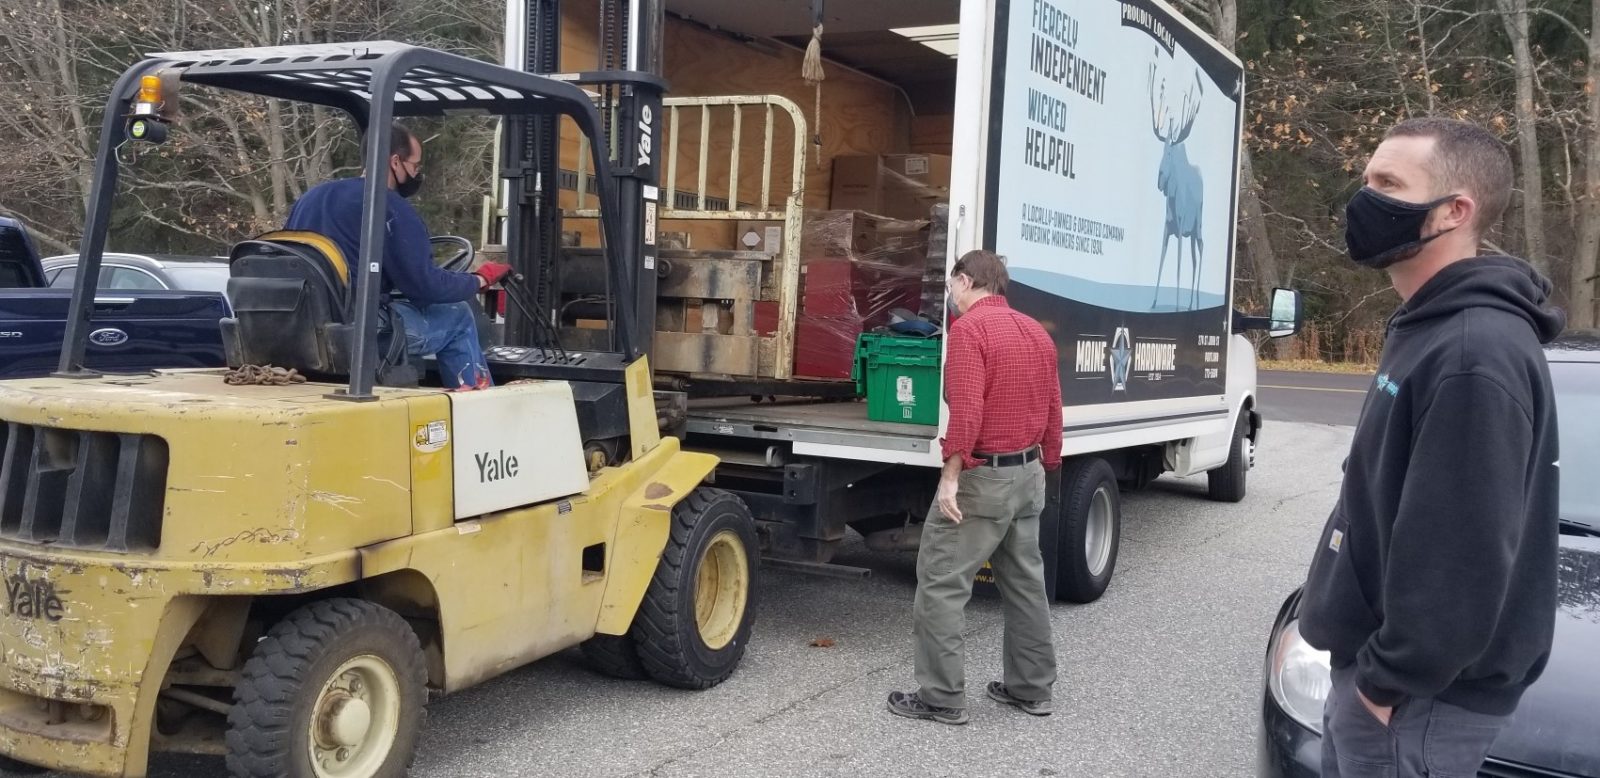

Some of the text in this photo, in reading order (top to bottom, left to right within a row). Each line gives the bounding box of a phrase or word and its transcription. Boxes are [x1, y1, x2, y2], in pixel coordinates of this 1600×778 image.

[1032, 0, 1079, 50] FIERCELY
[1122, 3, 1175, 51] PROUDLY LOCAL!
[1030, 32, 1107, 104] INDEPENDENT
[1028, 87, 1067, 133] WICKED
[637, 104, 653, 166] Yale
[1024, 126, 1076, 179] HELPFUL
[1021, 203, 1027, 220] A
[1021, 222, 1050, 246] POWERING
[1075, 235, 1090, 254] SINCE
[1075, 340, 1177, 372] MAINE HARDWARE
[474, 449, 519, 483] Yale
[4, 579, 65, 621] Yale
